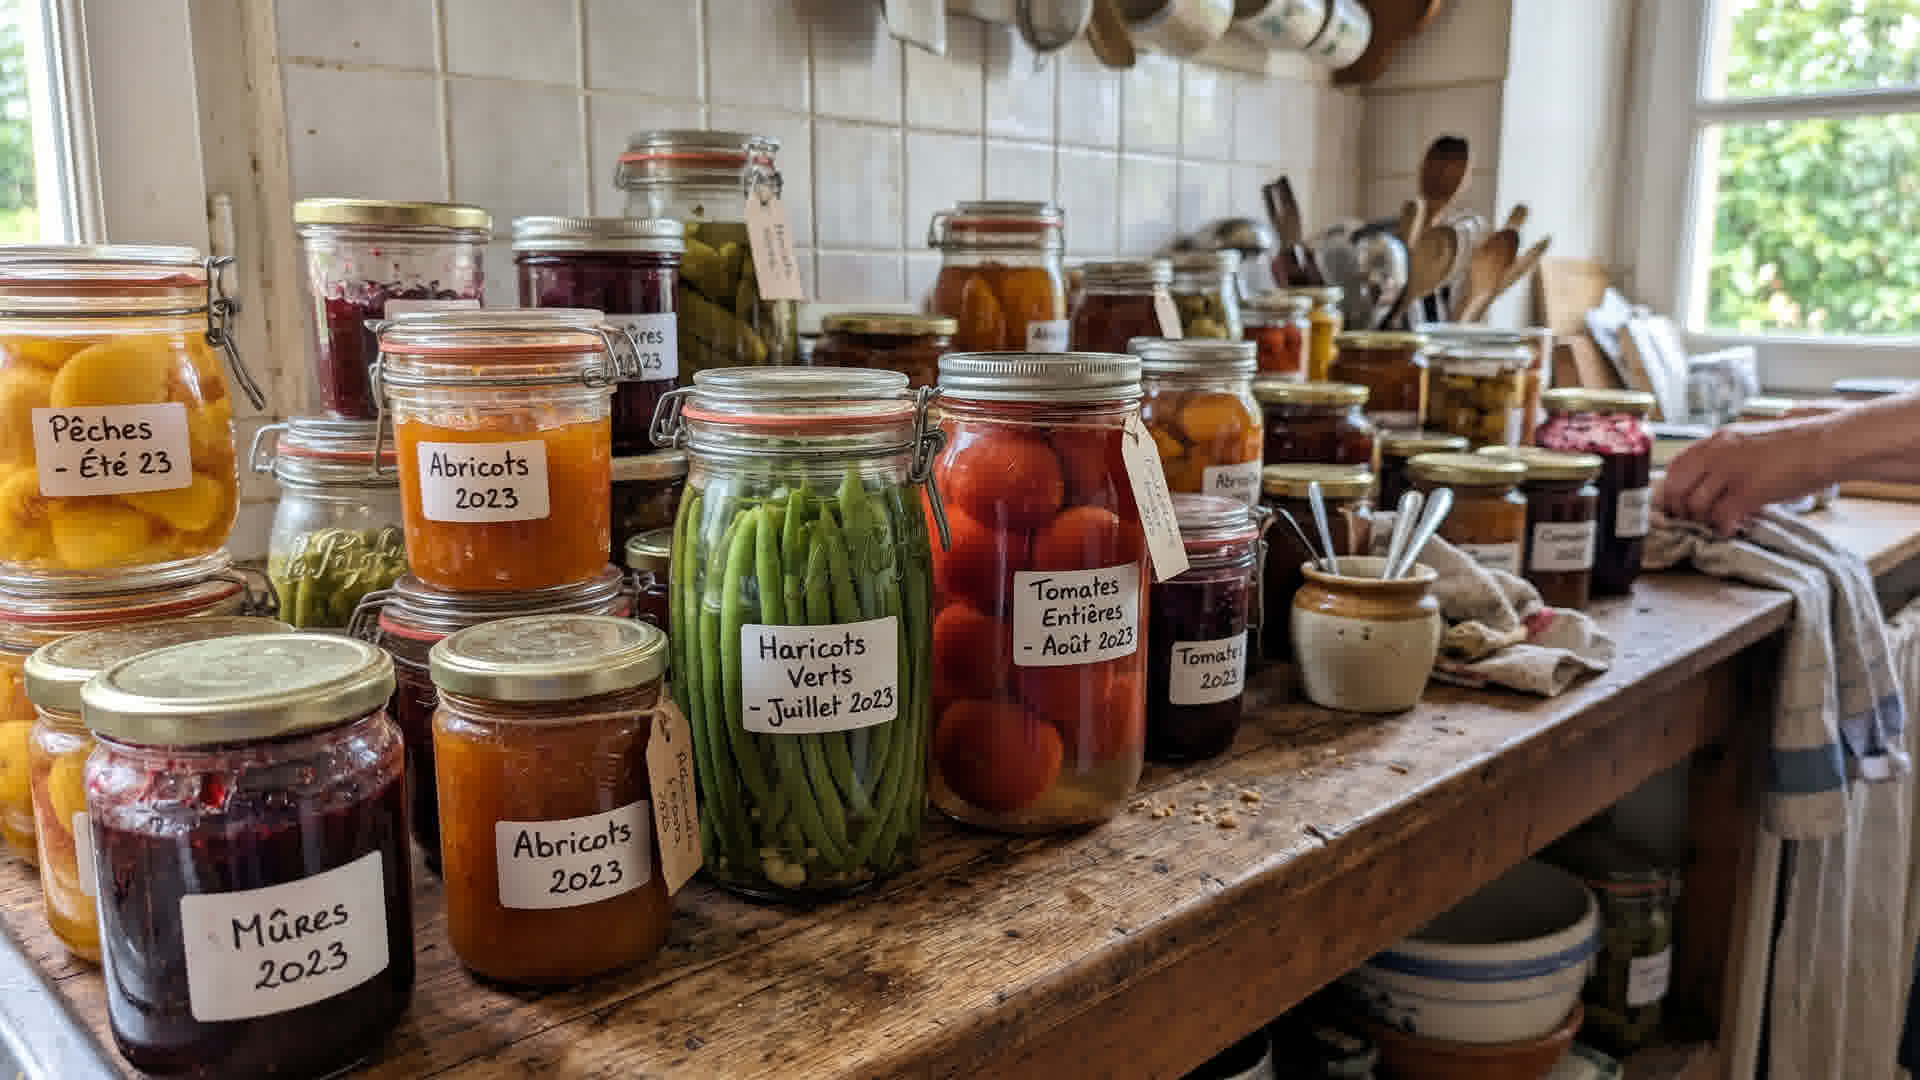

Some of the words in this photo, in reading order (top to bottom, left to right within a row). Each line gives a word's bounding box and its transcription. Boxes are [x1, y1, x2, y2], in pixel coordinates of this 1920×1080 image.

[49, 414, 153, 443] Pêches
[79, 448, 129, 478] Été
[139, 451, 173, 474] 23
[430, 449, 529, 477] Abricots
[455, 487, 519, 509] 2023
[1028, 575, 1120, 601] Tomates
[759, 631, 867, 661] Haricots
[1042, 632, 1092, 657] Août
[1098, 626, 1134, 650] 2023
[787, 663, 854, 689] Verts
[767, 695, 842, 728] Juillet
[848, 687, 894, 714] 2023
[513, 818, 633, 859] Abricots
[549, 859, 624, 894] 2023
[254, 941, 349, 990] 2023
